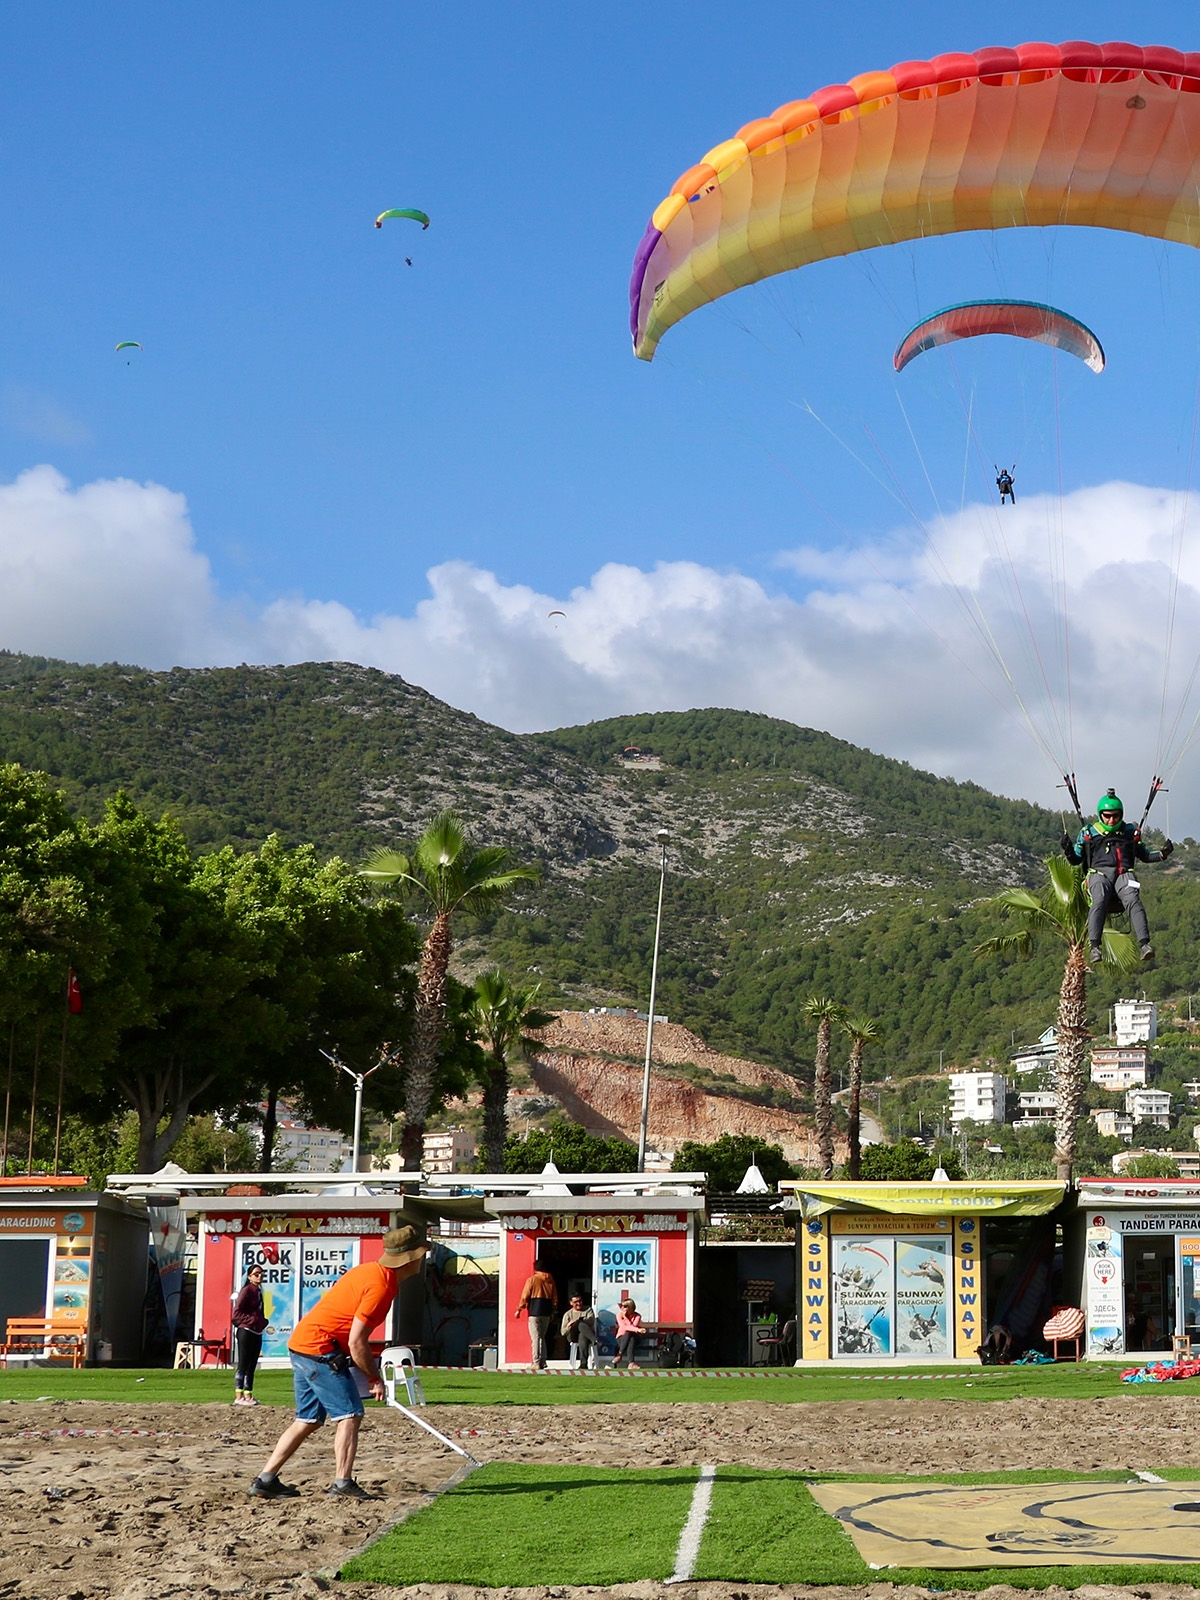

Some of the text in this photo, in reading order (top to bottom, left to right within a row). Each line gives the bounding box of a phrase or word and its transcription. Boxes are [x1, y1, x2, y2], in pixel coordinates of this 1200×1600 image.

[1124, 1189, 1179, 1197] ENGair
[950, 1197, 996, 1206] BOOK
[0, 1217, 56, 1228] ARAGLIDING
[259, 1217, 323, 1234] MYFLY
[848, 1222, 871, 1230] SUNWAY
[913, 1221, 936, 1229] TURİZM
[1120, 1220, 1166, 1230] TANDEM
[304, 1248, 348, 1261] BİLET
[601, 1250, 647, 1266] BOOK
[262, 1269, 290, 1283] ERE
[602, 1269, 646, 1283] HERE
[805, 1243, 824, 1341] SUNWAY
[897, 1290, 944, 1298] SUNWAY
[959, 1242, 977, 1339] SUNWAY
[1094, 1304, 1117, 1312] ЗДЕСЬ
